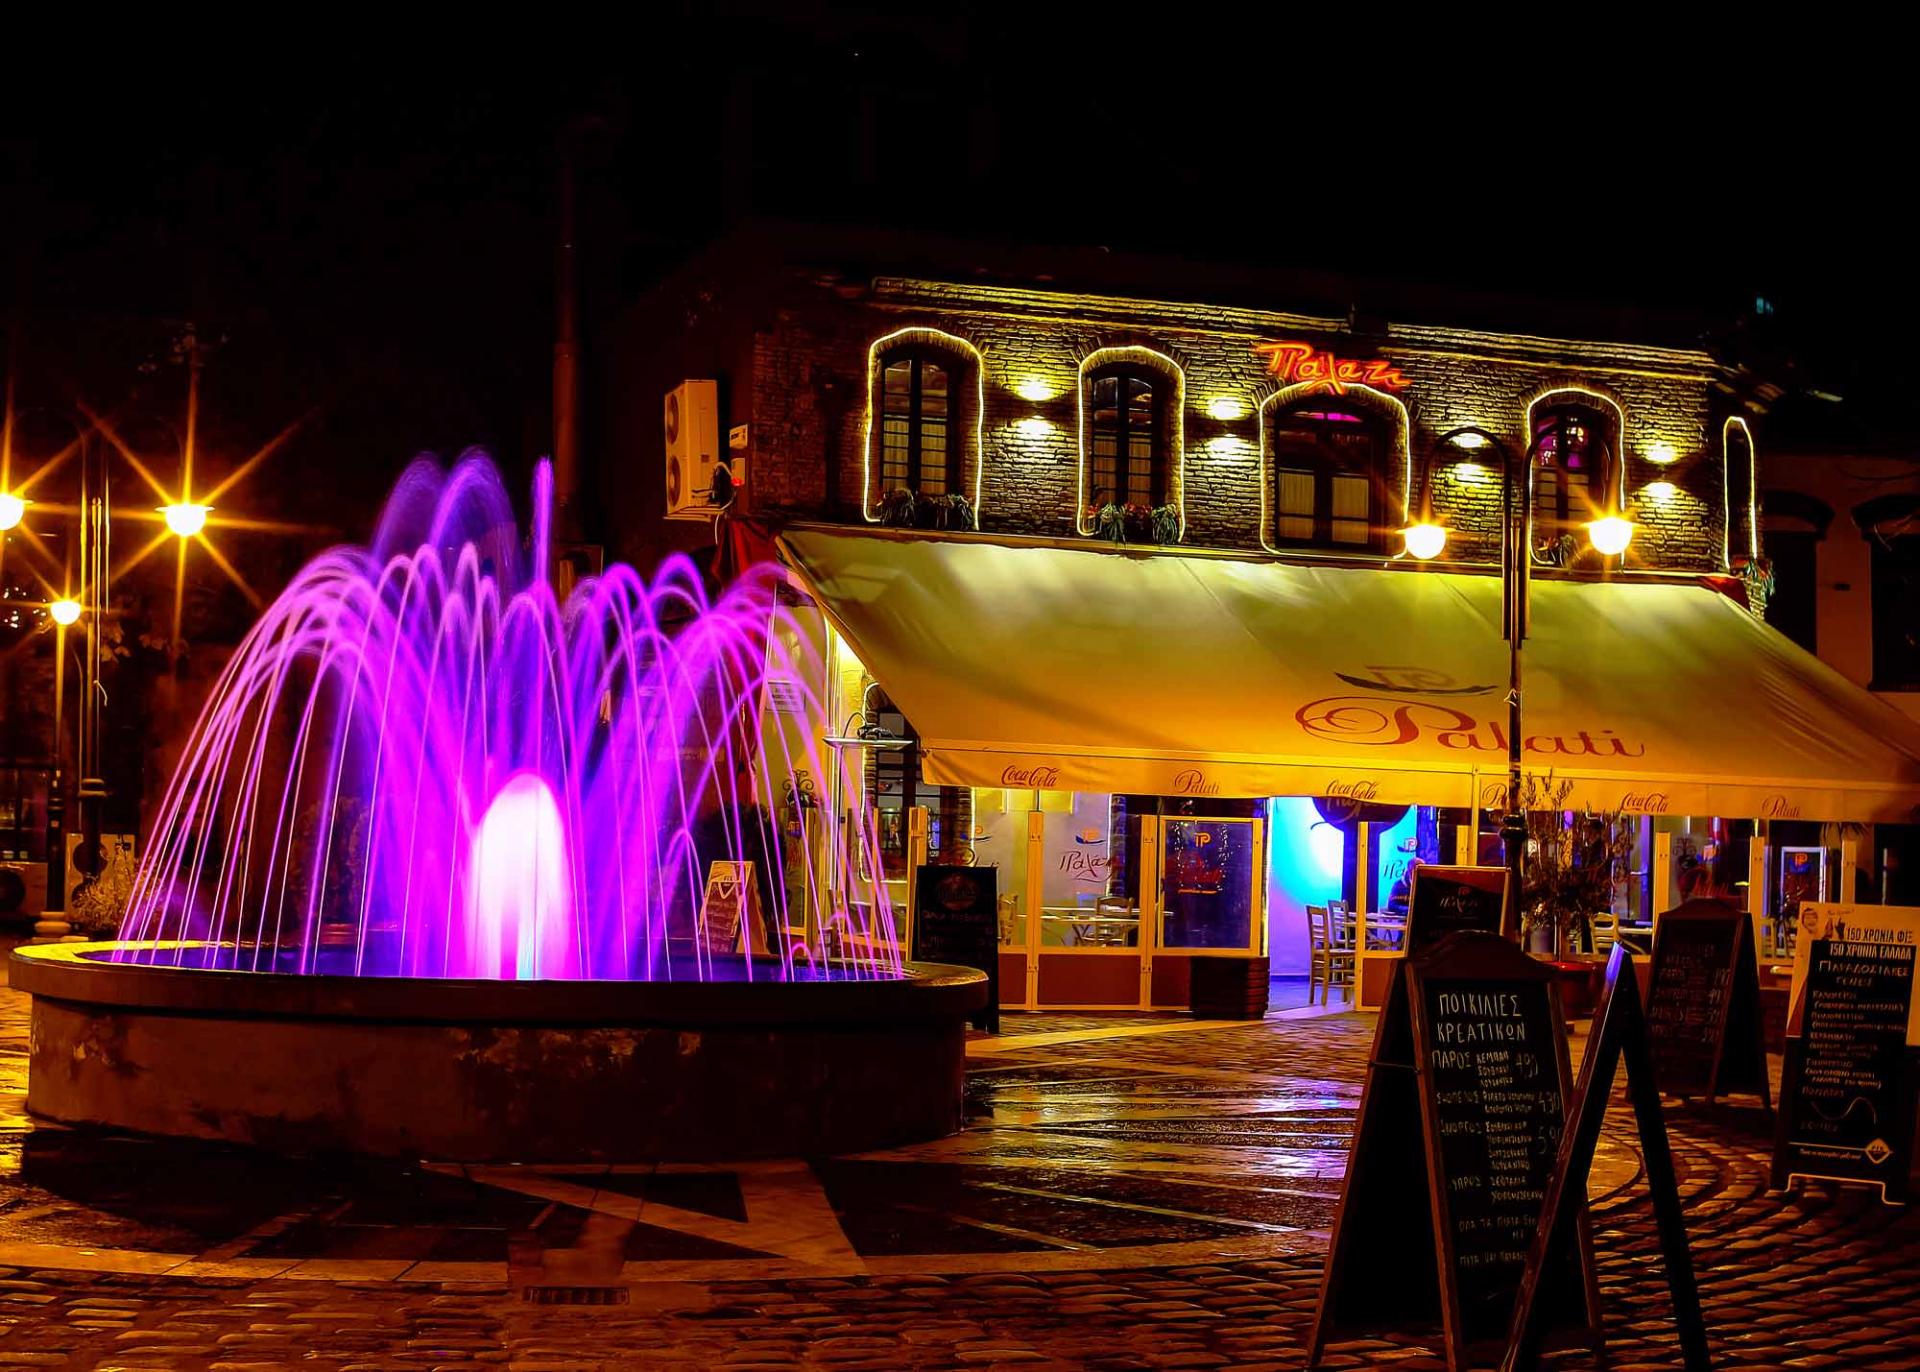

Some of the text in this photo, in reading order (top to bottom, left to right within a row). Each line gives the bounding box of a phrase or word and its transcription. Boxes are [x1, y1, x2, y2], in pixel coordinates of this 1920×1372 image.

[1295, 696, 1645, 757] Palati
[1863, 928, 1894, 943] ΧΡΟΝΙΑ
[1829, 943, 1911, 960] 150 ΧΡΟΝΙΑ ΕΛΛΑΔΑ
[1440, 992, 1522, 1017] ΠΟΙΚΙΛΙΕΣ
[1437, 1021, 1526, 1043] ΚΡΕΑΤΙΚΩΝ
[1432, 1050, 1471, 1070] ΠΑΡΟΣ
